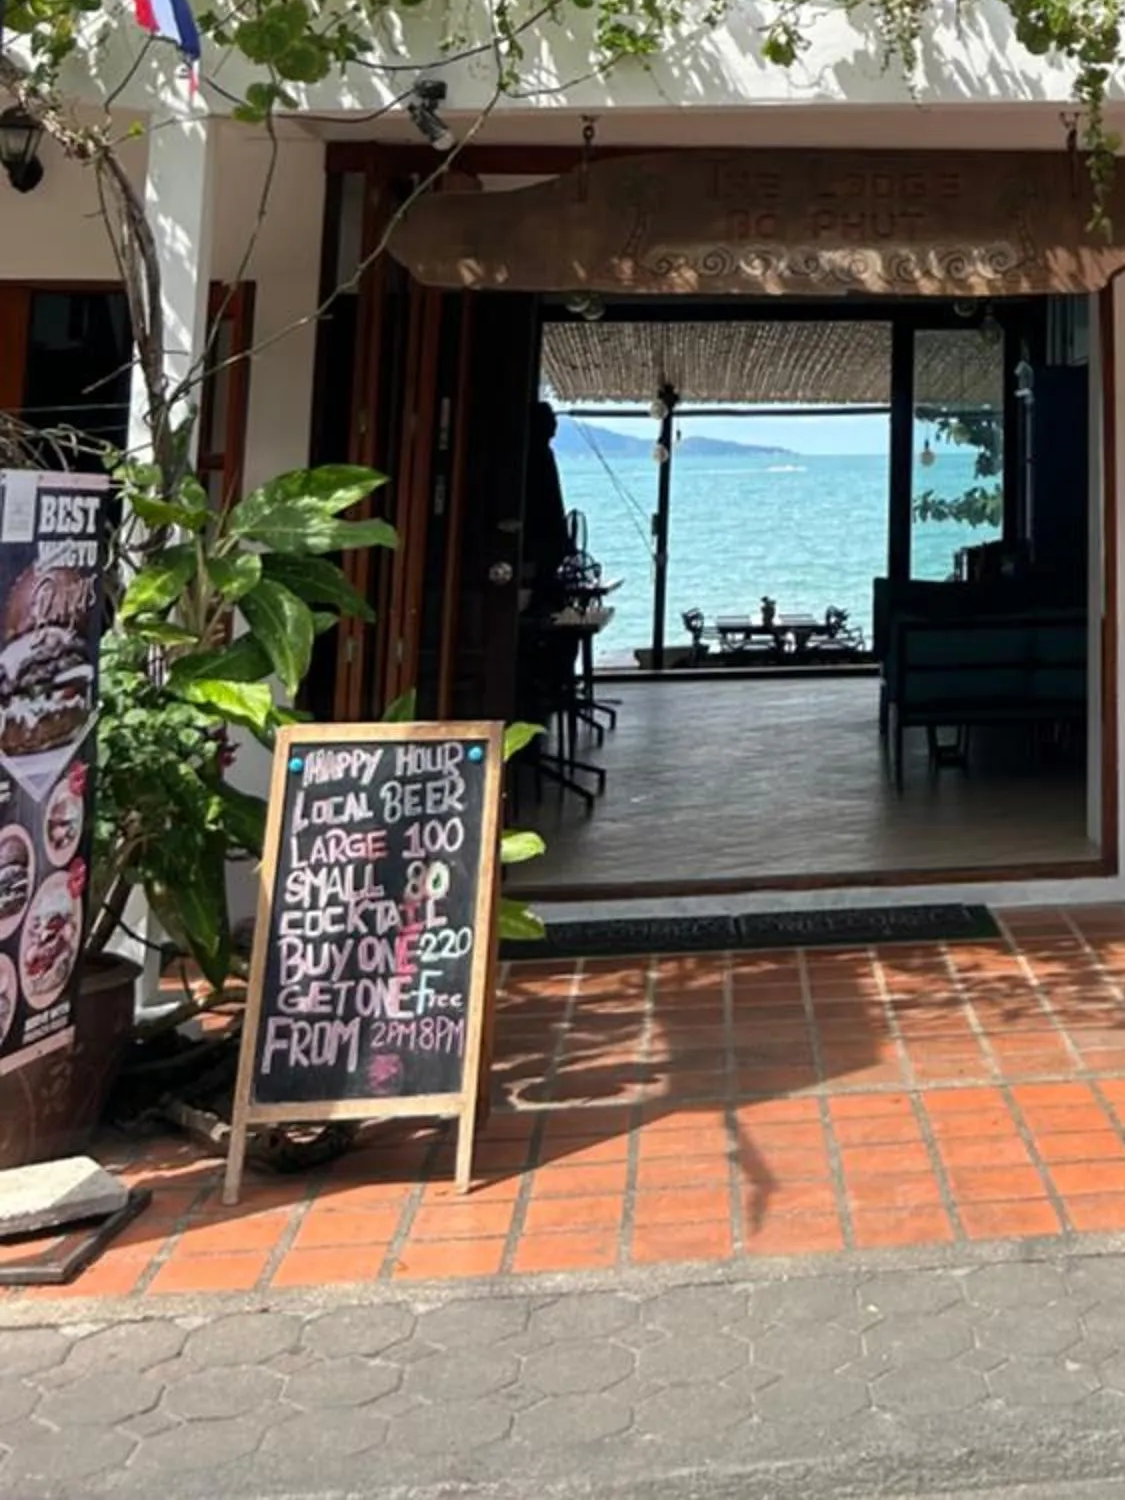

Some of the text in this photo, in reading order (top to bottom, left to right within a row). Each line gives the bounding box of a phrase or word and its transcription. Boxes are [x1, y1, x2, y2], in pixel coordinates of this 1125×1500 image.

[703, 157, 961, 199] THE LODGE
[810, 208, 927, 240] PHUT
[38, 495, 101, 534] BEST
[302, 741, 465, 789] HAPPY HOUR
[292, 775, 467, 836] LOCAL BEER
[289, 816, 466, 870] LARGE 100
[284, 860, 452, 910] SMALL 80
[279, 898, 449, 938] COCKTAIL
[277, 926, 474, 987] BUY ONE 220
[276, 979, 356, 1016] GET
[355, 975, 415, 1019] ONE
[260, 1015, 362, 1076] FROM
